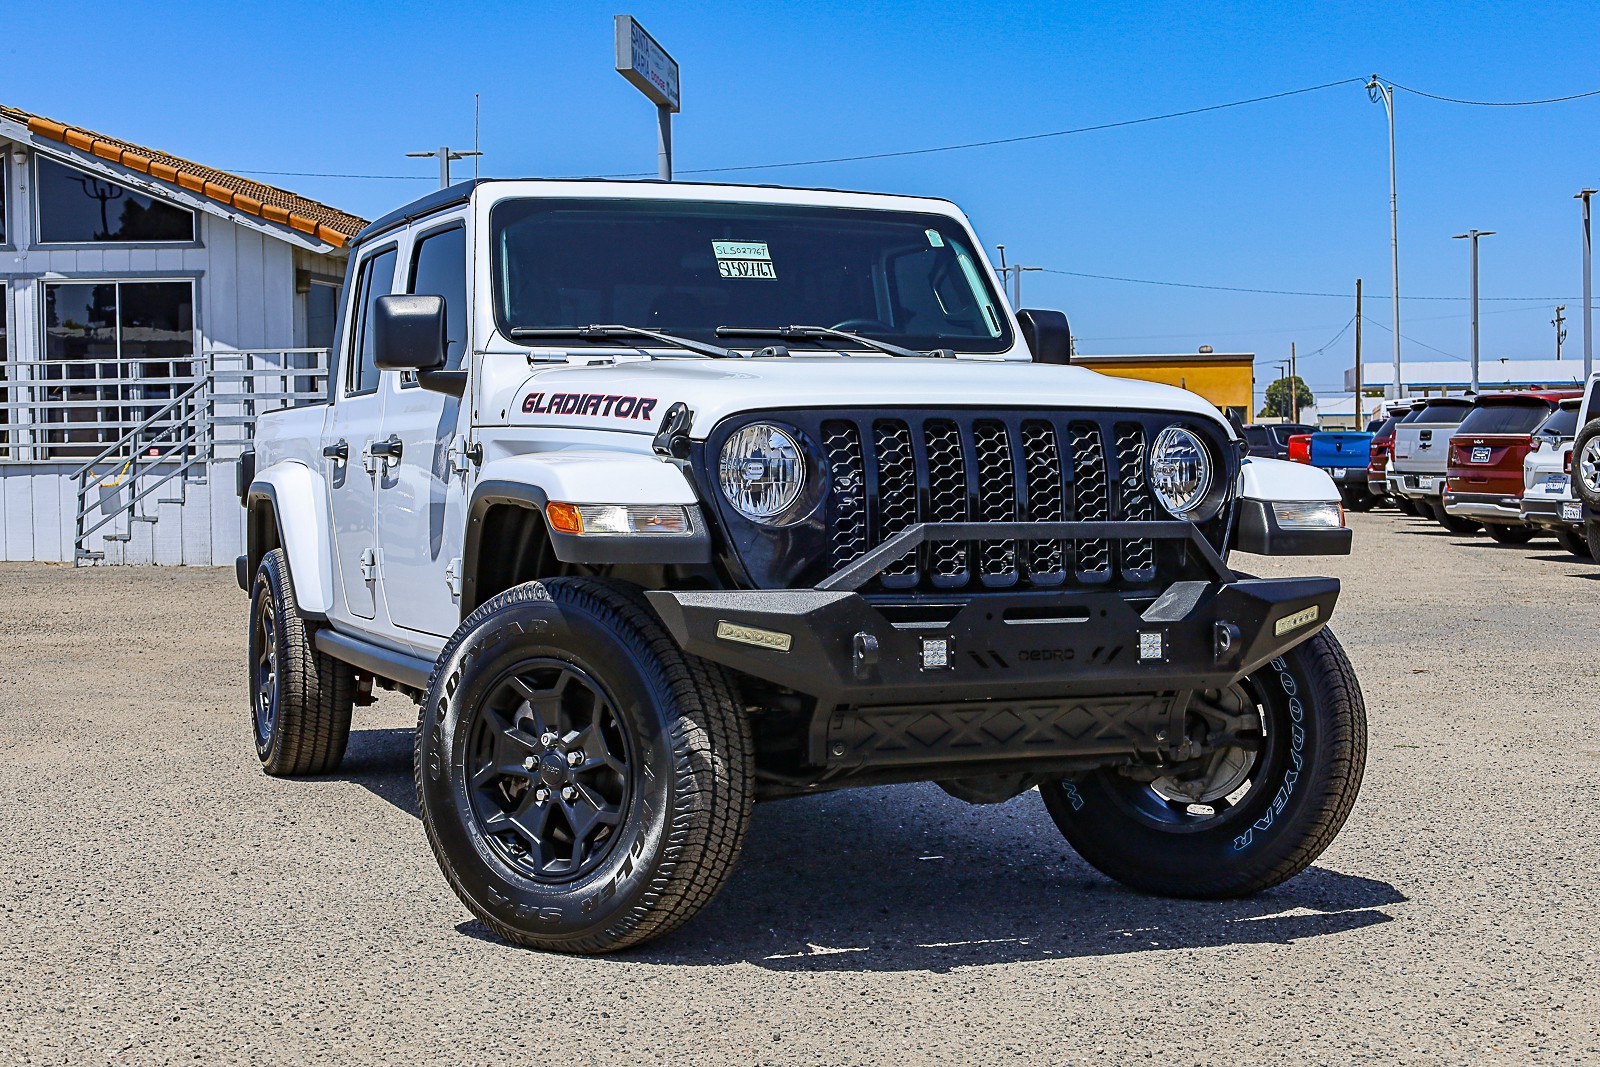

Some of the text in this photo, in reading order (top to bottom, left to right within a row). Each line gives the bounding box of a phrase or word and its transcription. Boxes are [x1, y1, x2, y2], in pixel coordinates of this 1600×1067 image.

[631, 23, 650, 57] SANTA
[632, 47, 650, 79] MARIA
[522, 393, 658, 420] GLADIATOR
[429, 619, 549, 781] GOODYEAR
